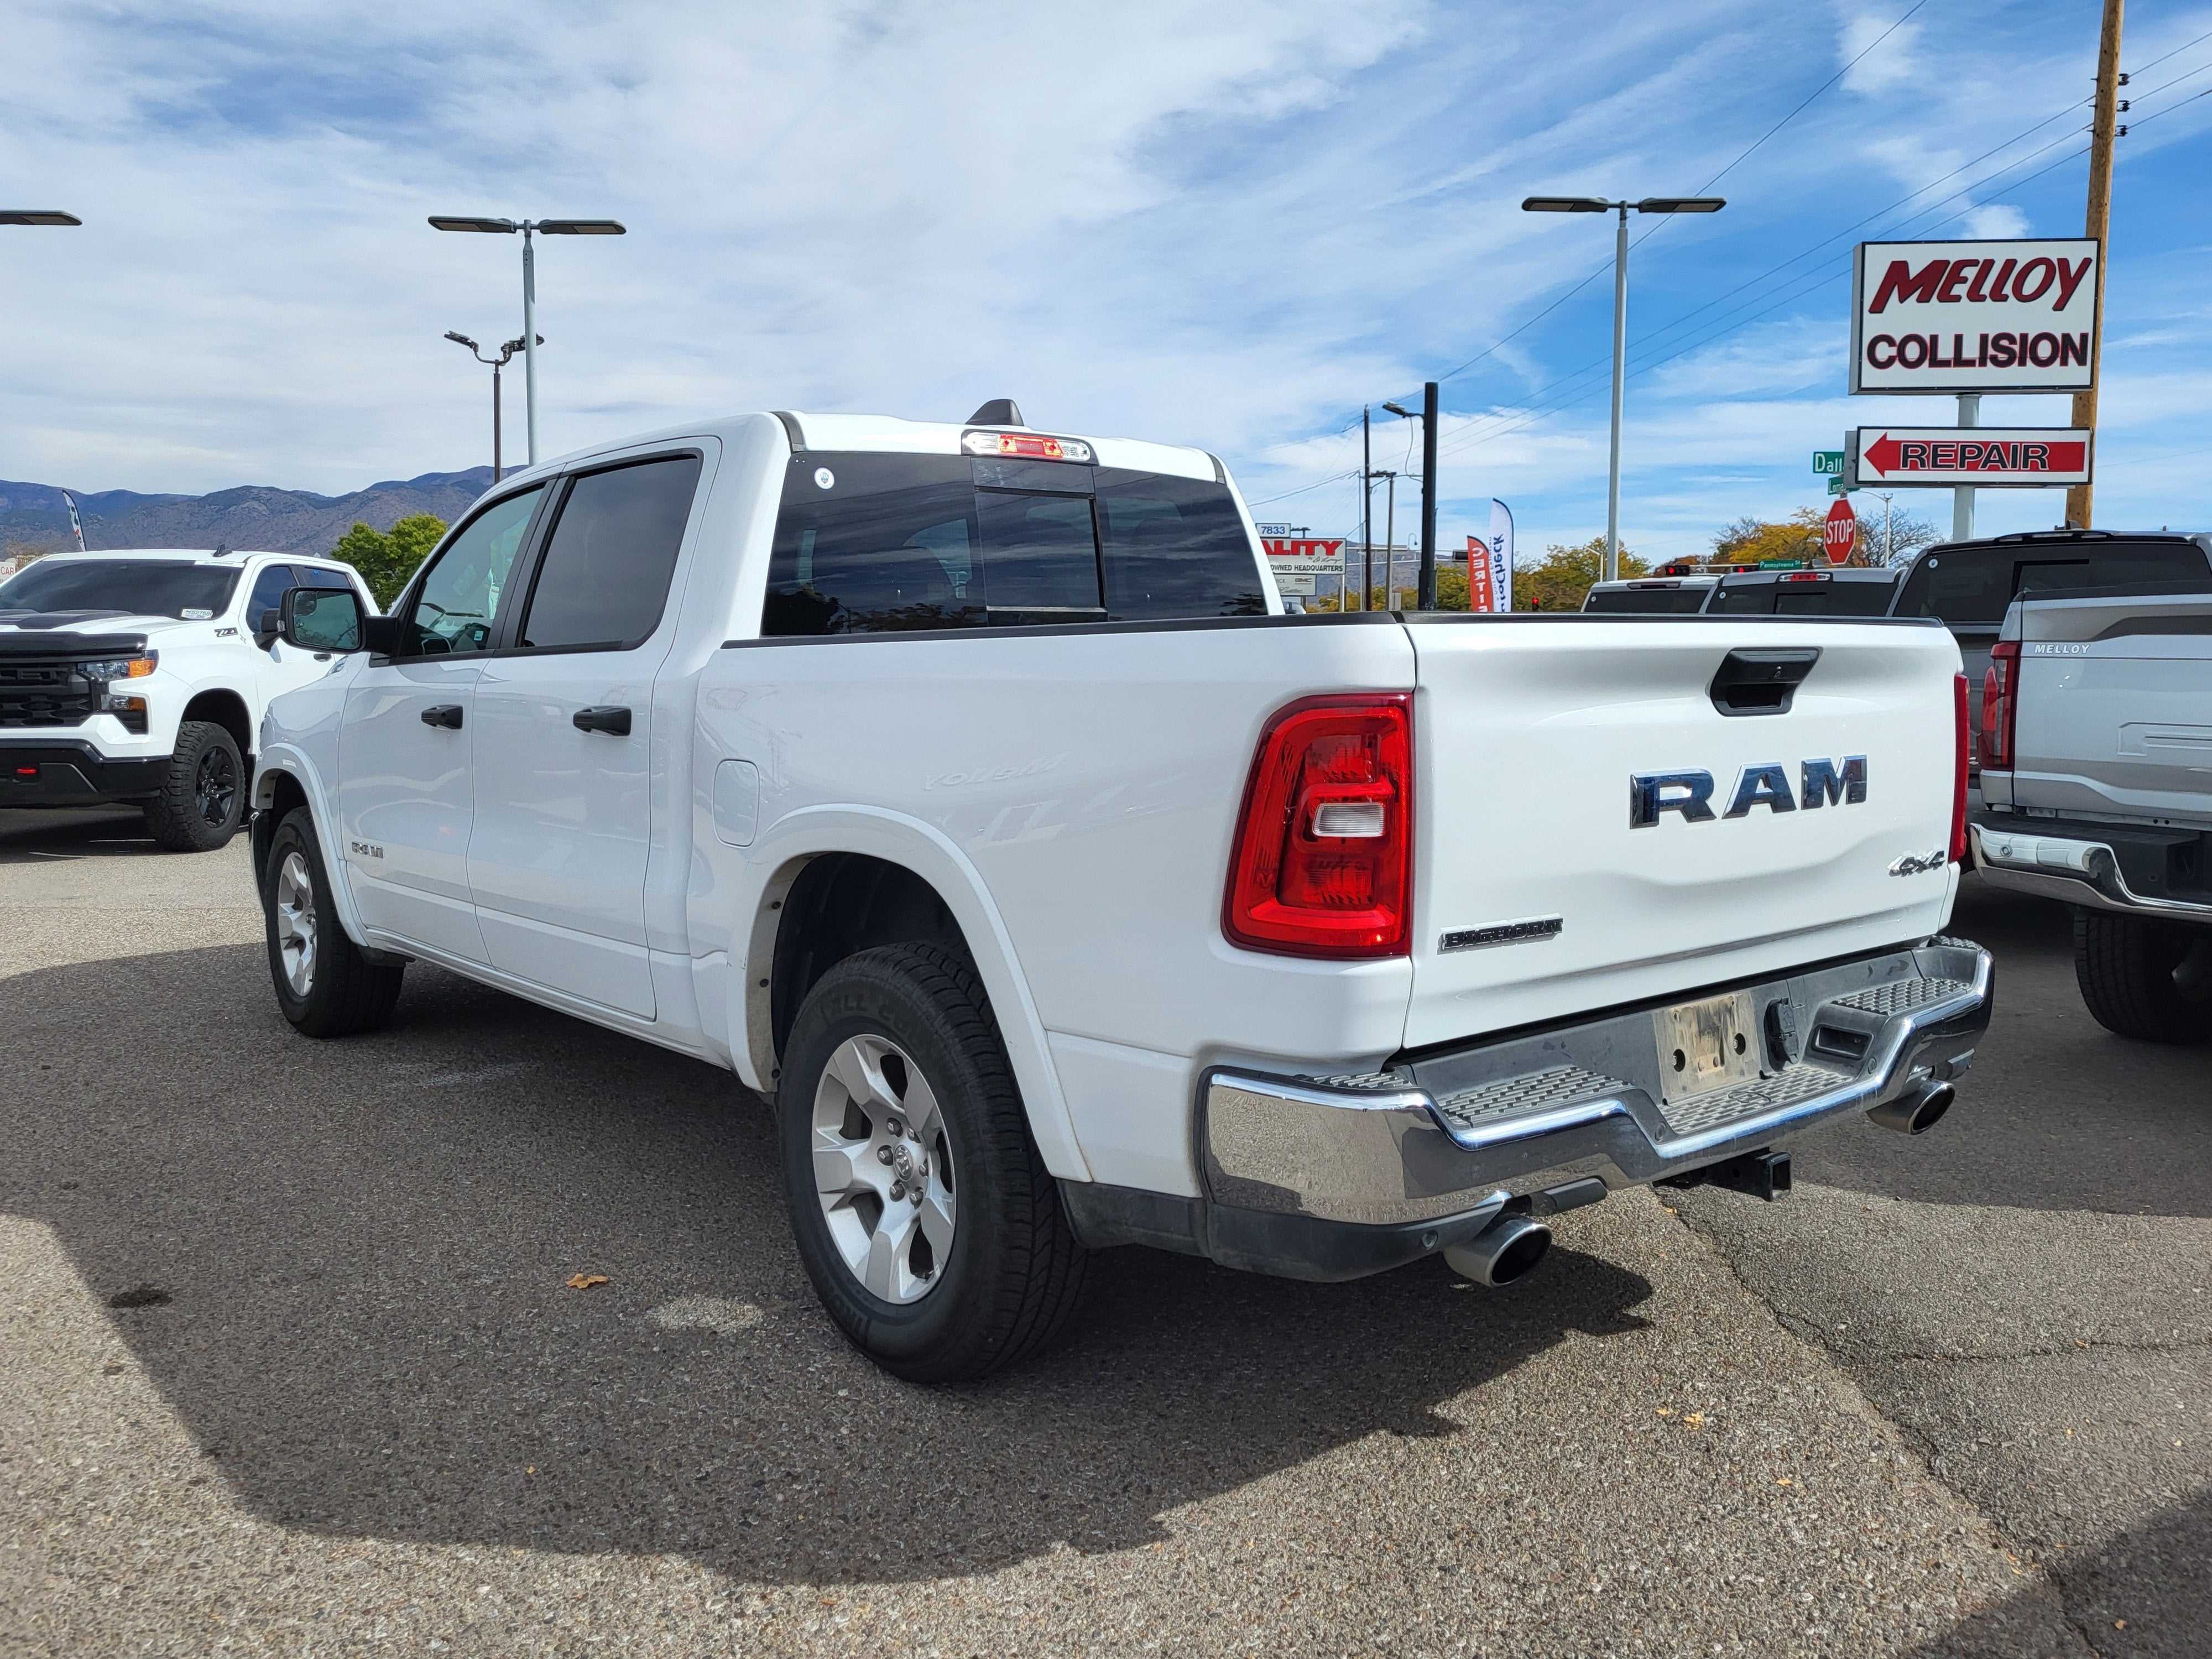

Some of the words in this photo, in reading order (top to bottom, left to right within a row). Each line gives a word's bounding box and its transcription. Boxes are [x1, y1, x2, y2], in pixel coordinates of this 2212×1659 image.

[1869, 257, 2093, 314] MELLOY
[1867, 332, 2089, 369] COLLISION
[1815, 453, 1844, 472] Dall
[1901, 442, 2049, 471] REPAIR
[1261, 526, 1286, 534] 7833
[1827, 519, 1853, 545] STOP
[2034, 644, 2090, 654] MELLOY
[1630, 754, 1867, 830] RAM
[351, 841, 384, 859] RAM
